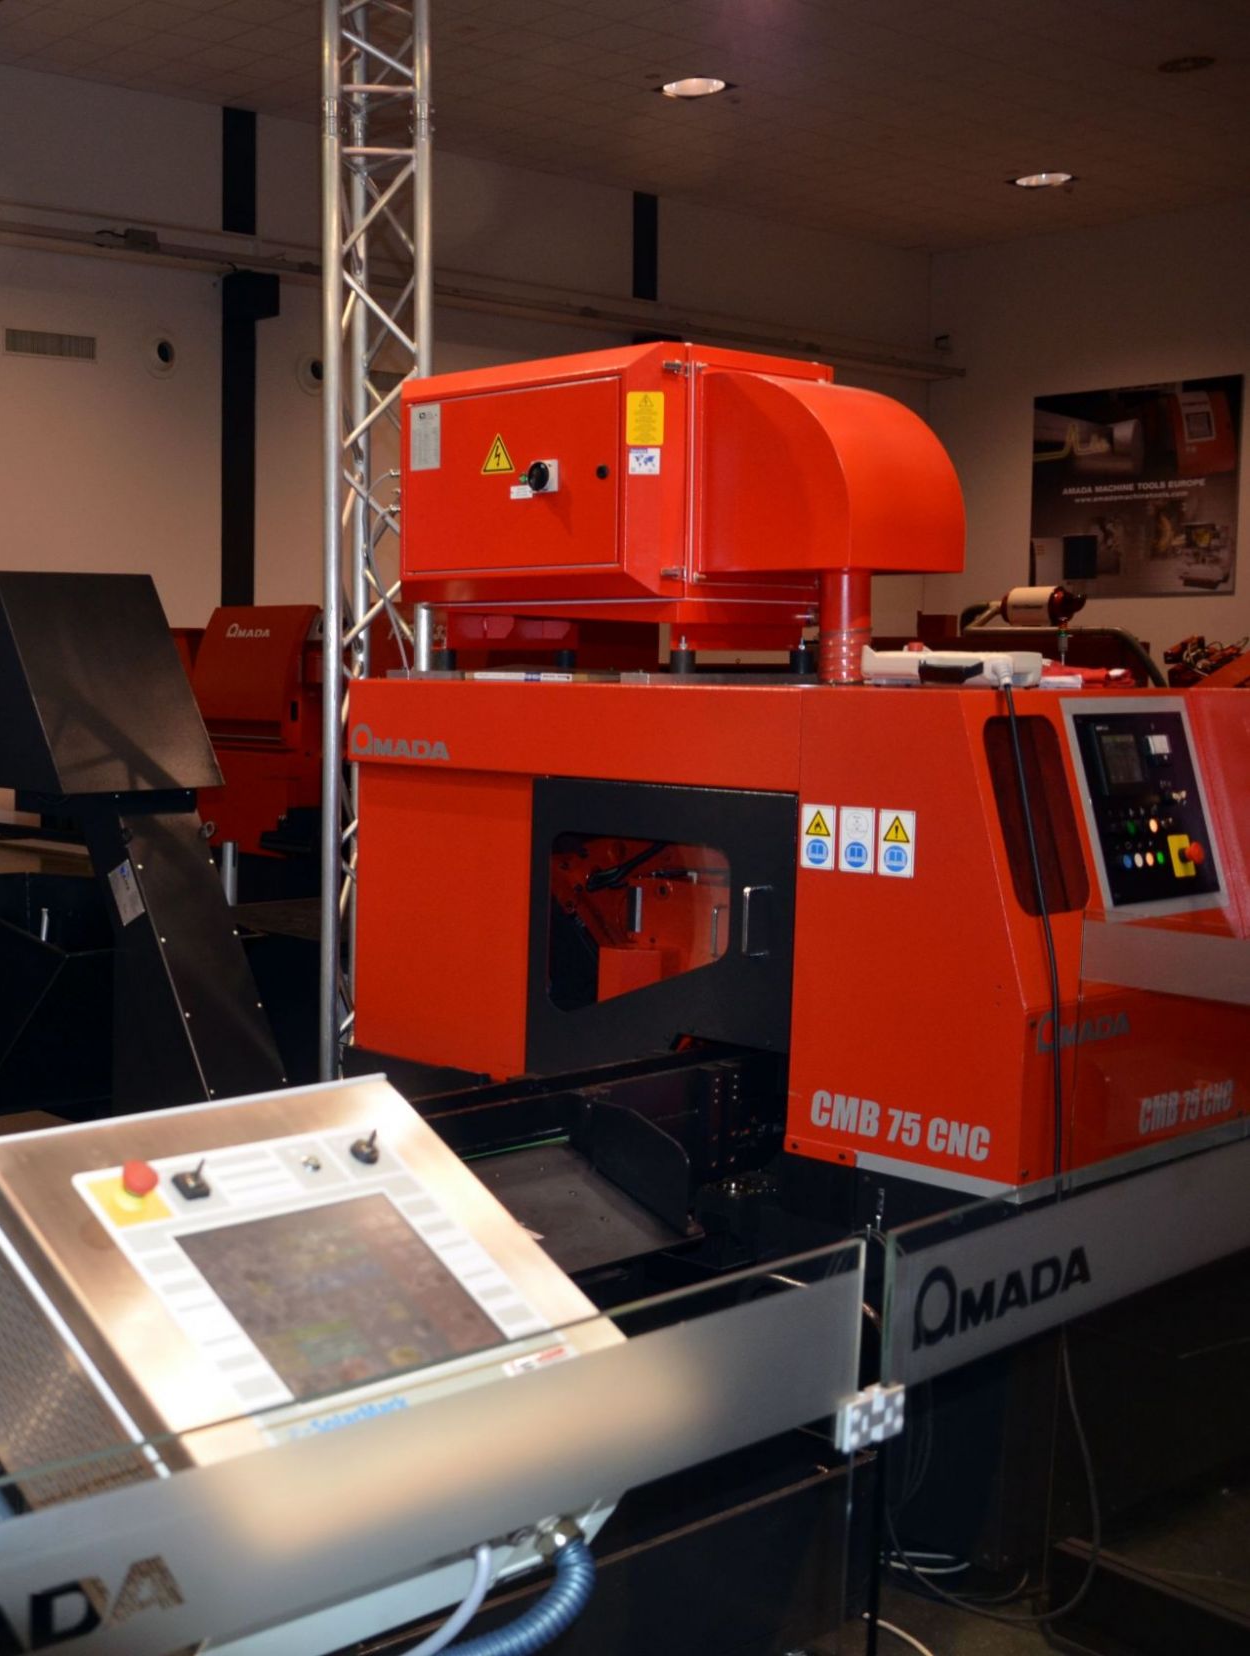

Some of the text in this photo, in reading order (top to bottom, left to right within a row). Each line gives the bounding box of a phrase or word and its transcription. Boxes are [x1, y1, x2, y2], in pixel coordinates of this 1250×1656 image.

[1095, 483, 1134, 493] MACHINE
[1137, 481, 1166, 491] TOOLS
[1168, 478, 1206, 488] EUROPE
[226, 623, 270, 638] AMADA
[351, 723, 450, 760] AMADA
[1037, 1011, 1131, 1055] AMADA
[811, 1090, 991, 1161] CMB 75 CNC
[1139, 1080, 1234, 1136] CMB 75 CNC
[913, 1246, 1091, 1351] AMADA
